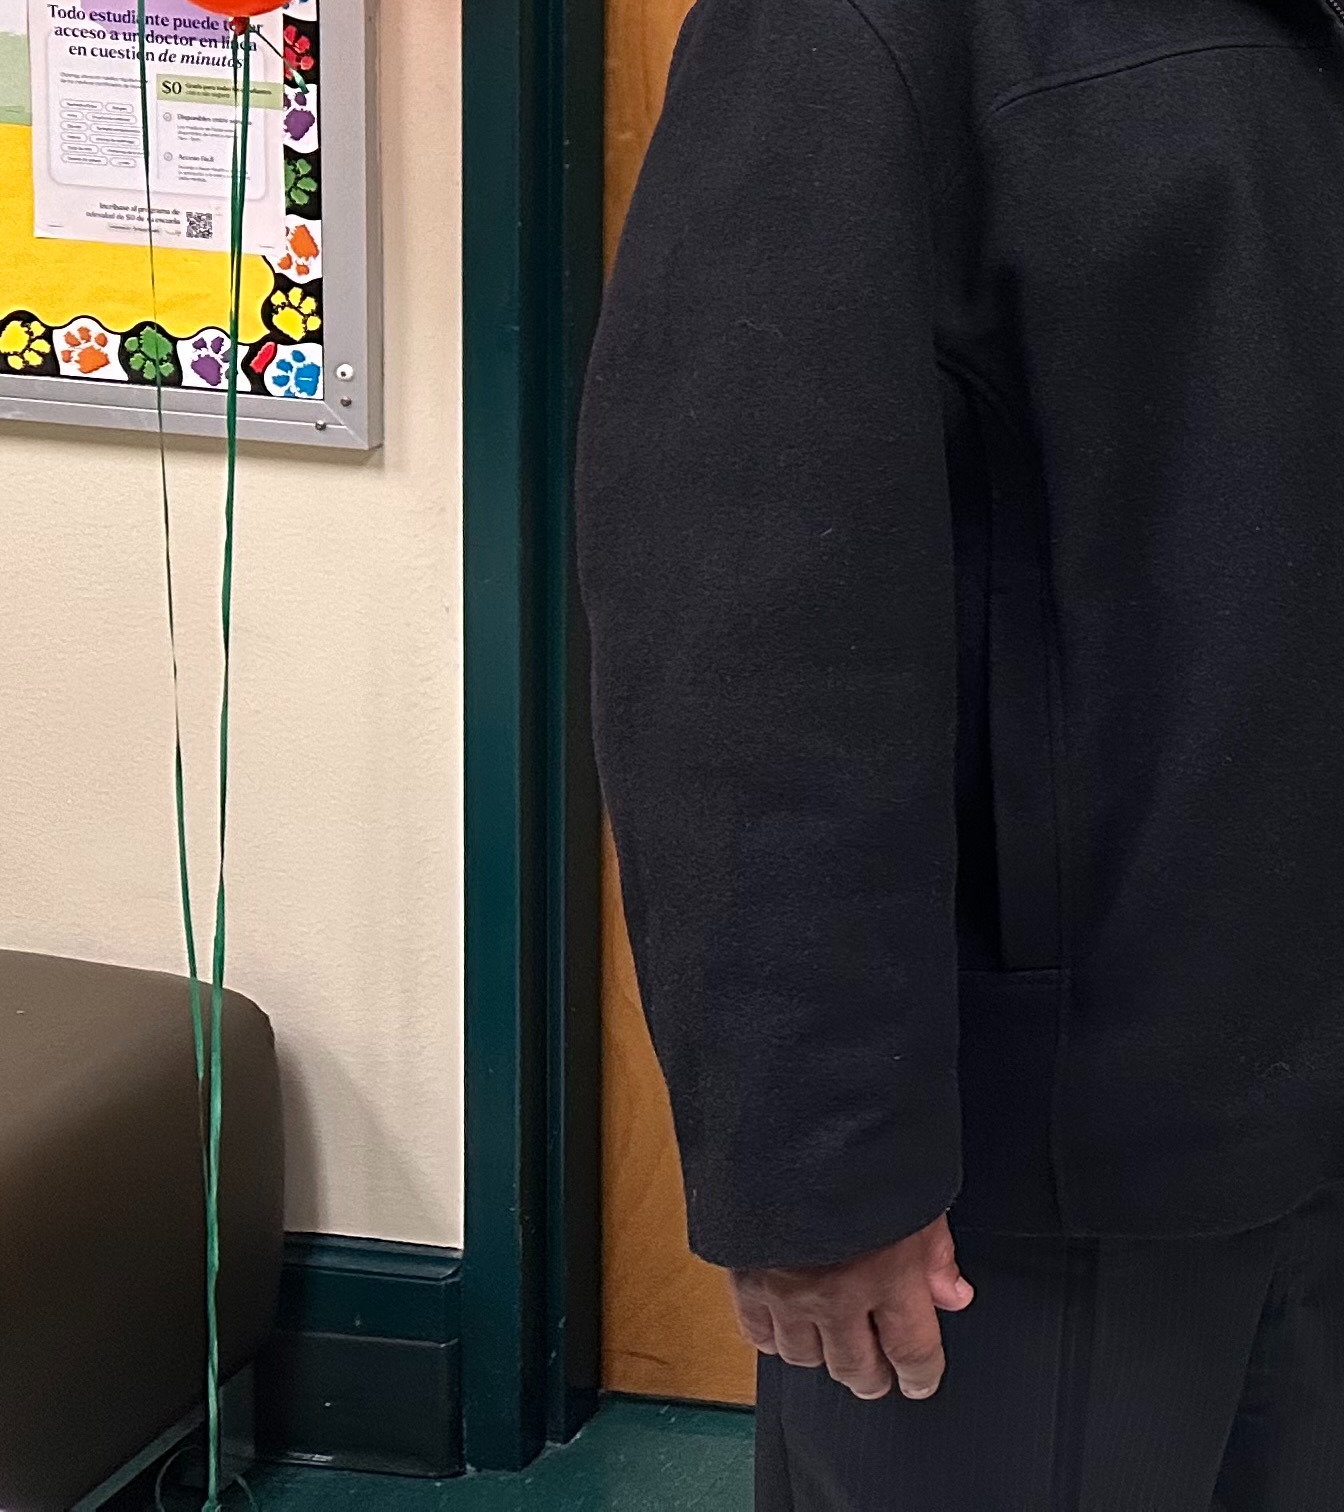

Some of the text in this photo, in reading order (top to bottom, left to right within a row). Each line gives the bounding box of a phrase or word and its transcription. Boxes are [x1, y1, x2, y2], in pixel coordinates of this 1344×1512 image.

[47, 4, 86, 20] Todo
[89, 9, 170, 27] estudinte
[173, 16, 220, 31] puede
[54, 25, 106, 41] acceso
[109, 30, 119, 41] a
[145, 29, 194, 48] doctor
[199, 37, 218, 49] en
[68, 45, 87, 57] en
[158, 48, 177, 63] de
[180, 50, 244, 69] minutos
